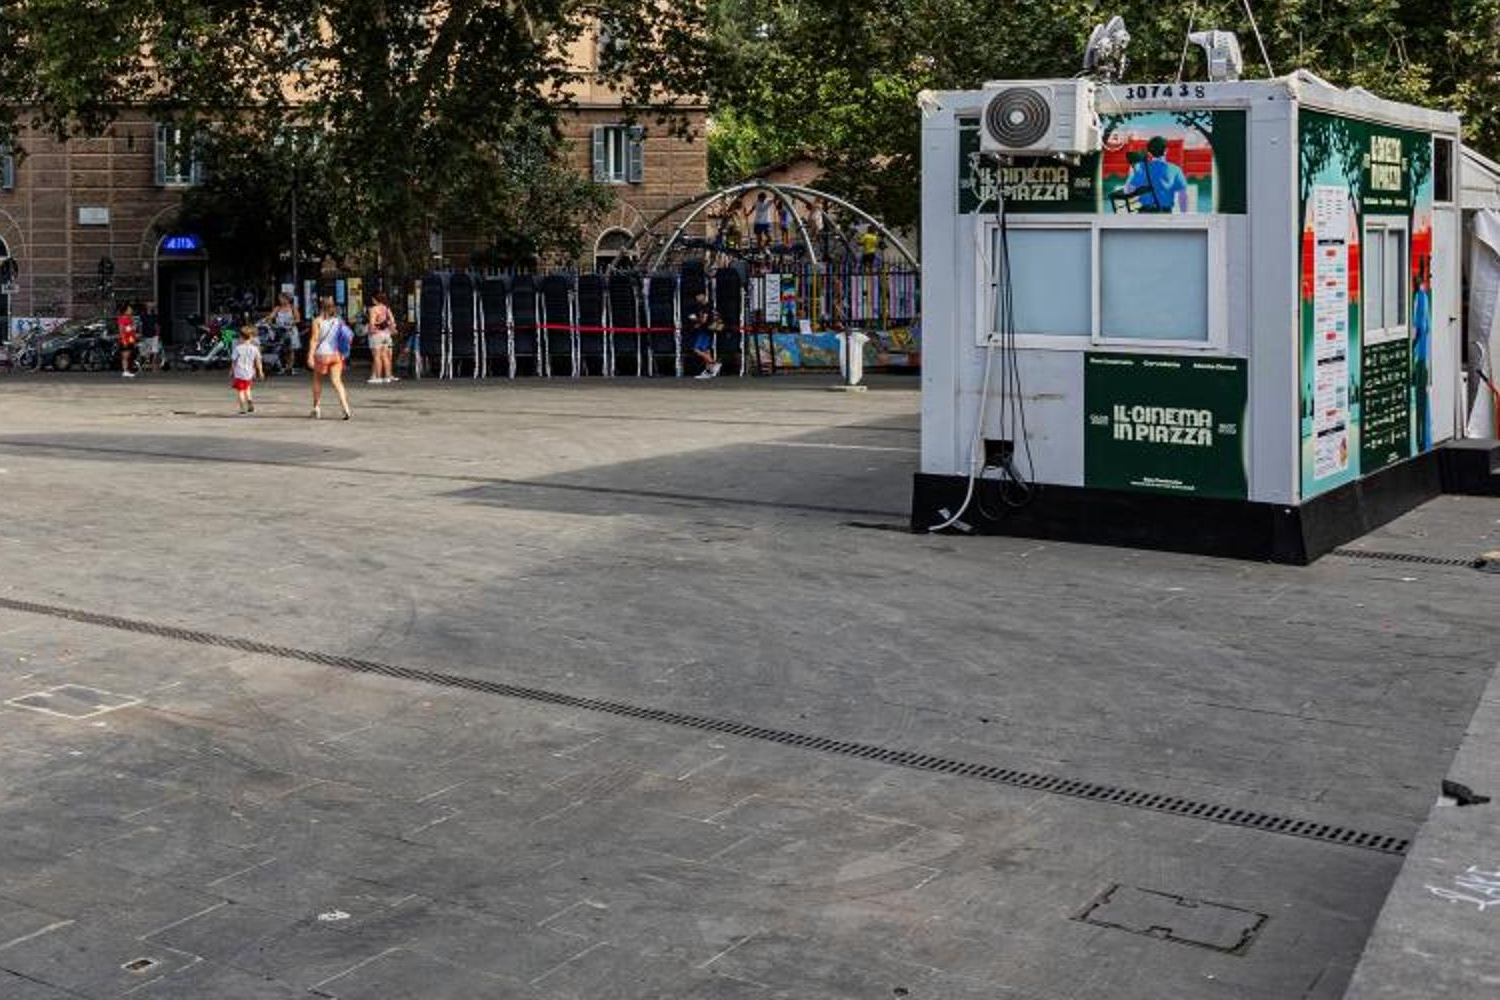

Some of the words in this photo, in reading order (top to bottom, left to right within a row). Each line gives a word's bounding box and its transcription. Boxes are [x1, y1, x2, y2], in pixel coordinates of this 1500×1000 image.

[1131, 406, 1213, 427] CINEMA
[1113, 424, 1133, 440] IN
[1135, 425, 1213, 446] PIAZZA
